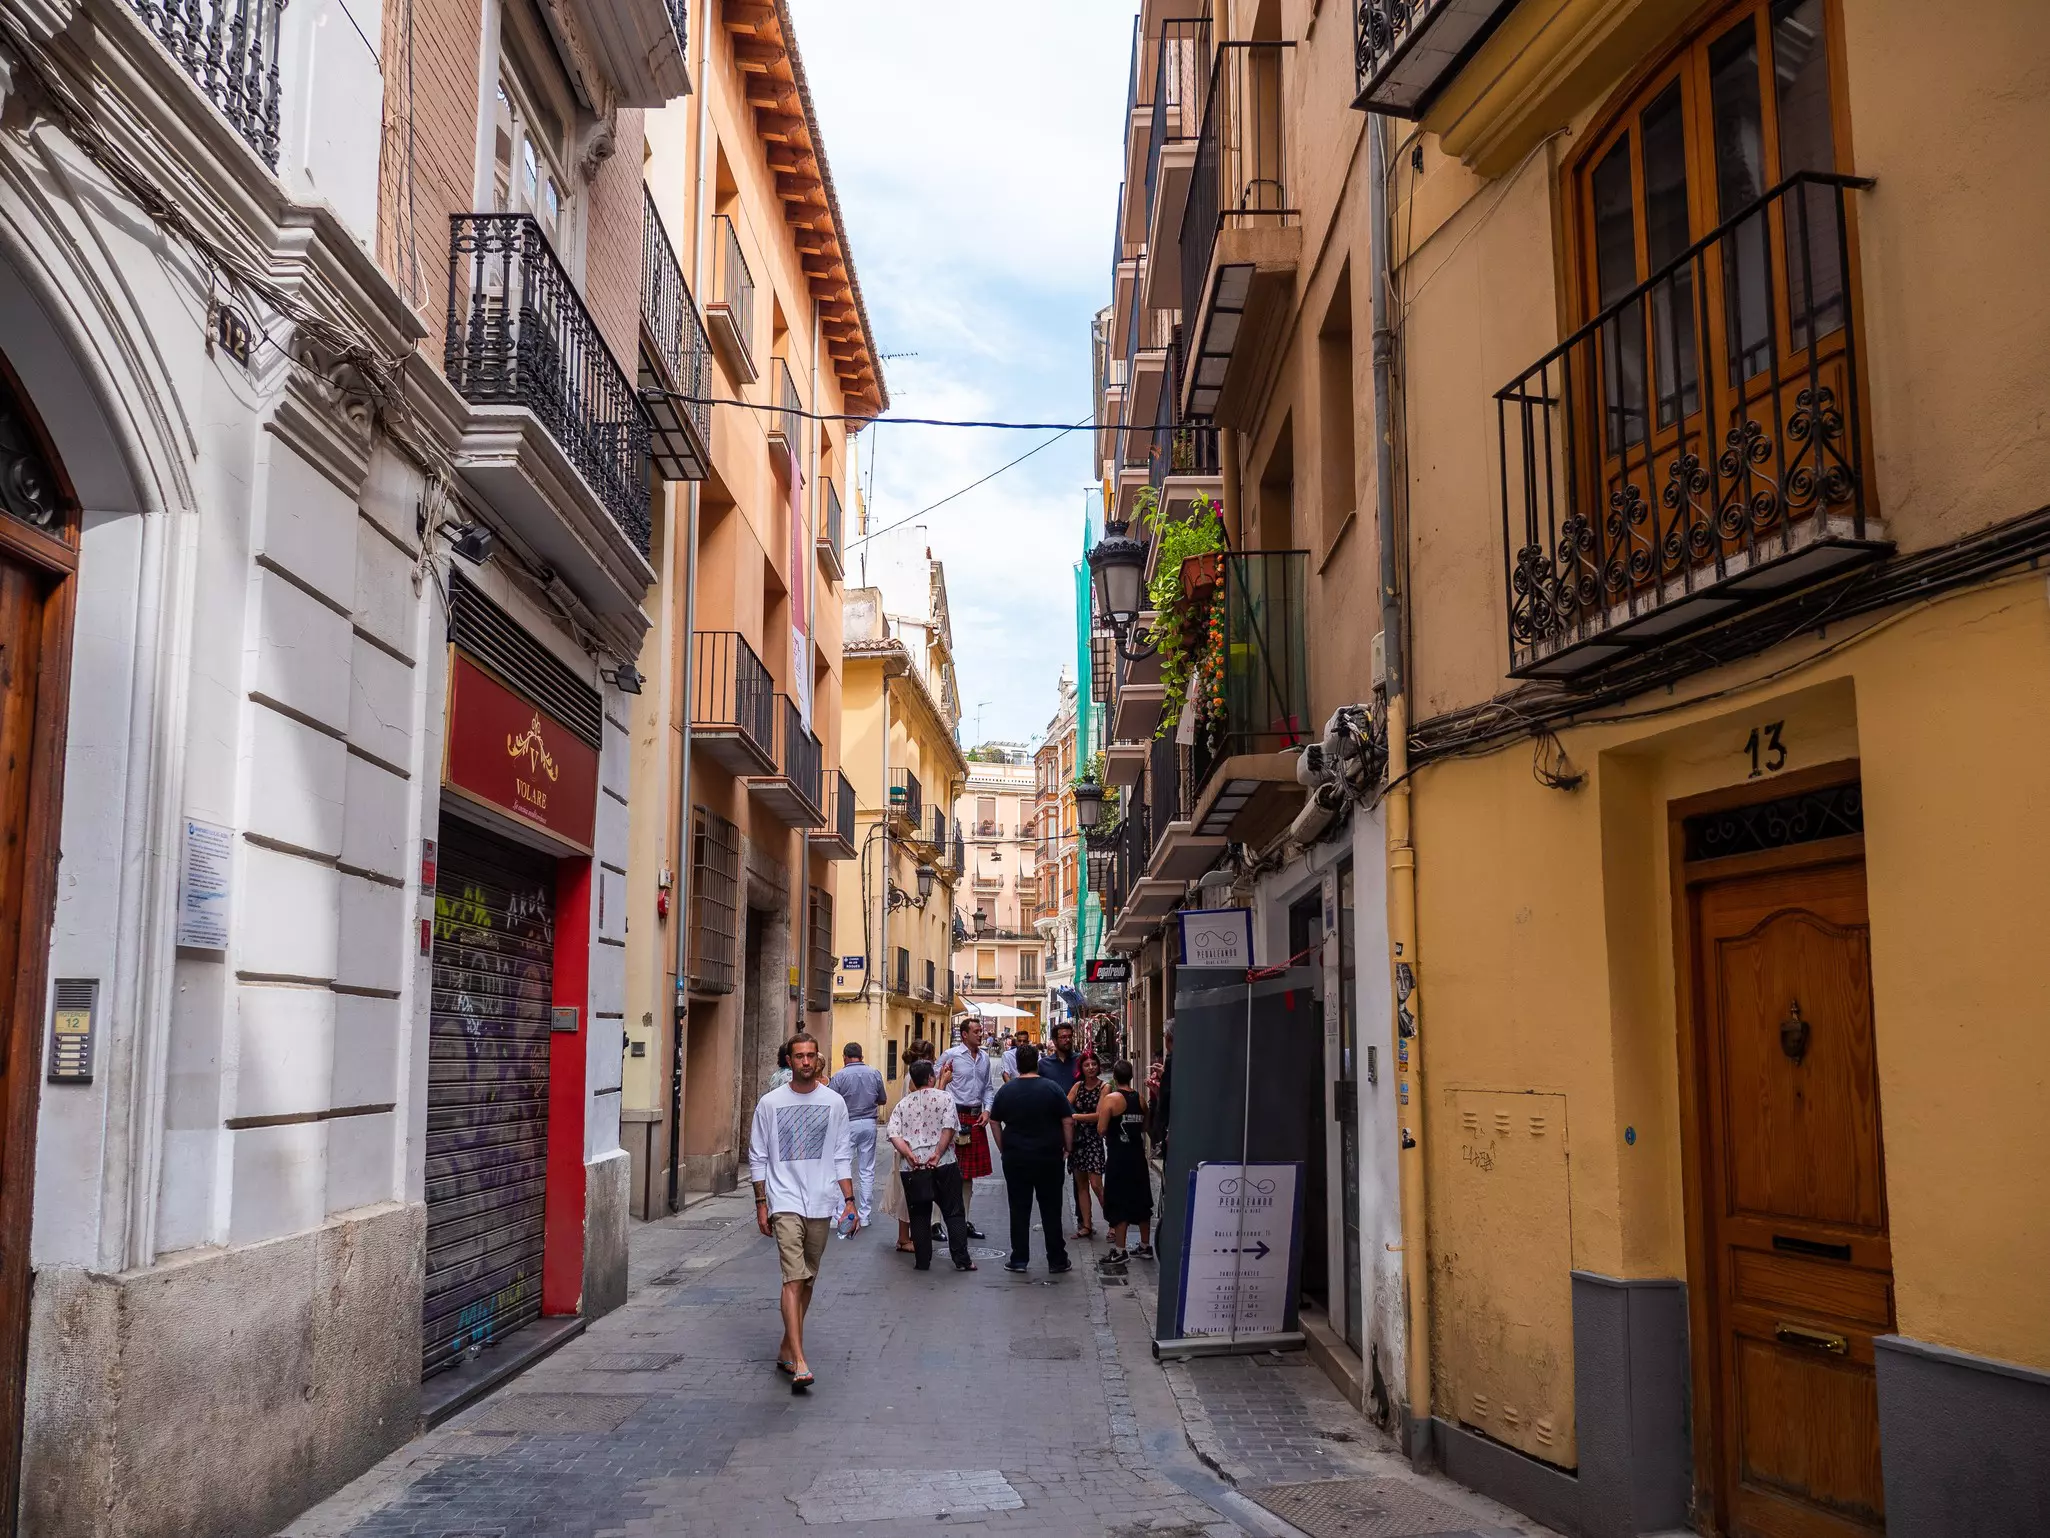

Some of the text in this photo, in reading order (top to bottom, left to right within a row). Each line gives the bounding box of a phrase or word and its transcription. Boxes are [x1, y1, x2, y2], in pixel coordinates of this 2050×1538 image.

[225, 316, 246, 360] 12
[530, 746, 539, 774] V
[1743, 719, 1788, 779] 13
[516, 778, 547, 810] VOLARE
[1197, 949, 1237, 959] PEDALEANDO
[1089, 961, 1125, 981] Segafredo
[65, 1018, 80, 1028] 12
[1219, 1197, 1273, 1206] PEDAEANDO
